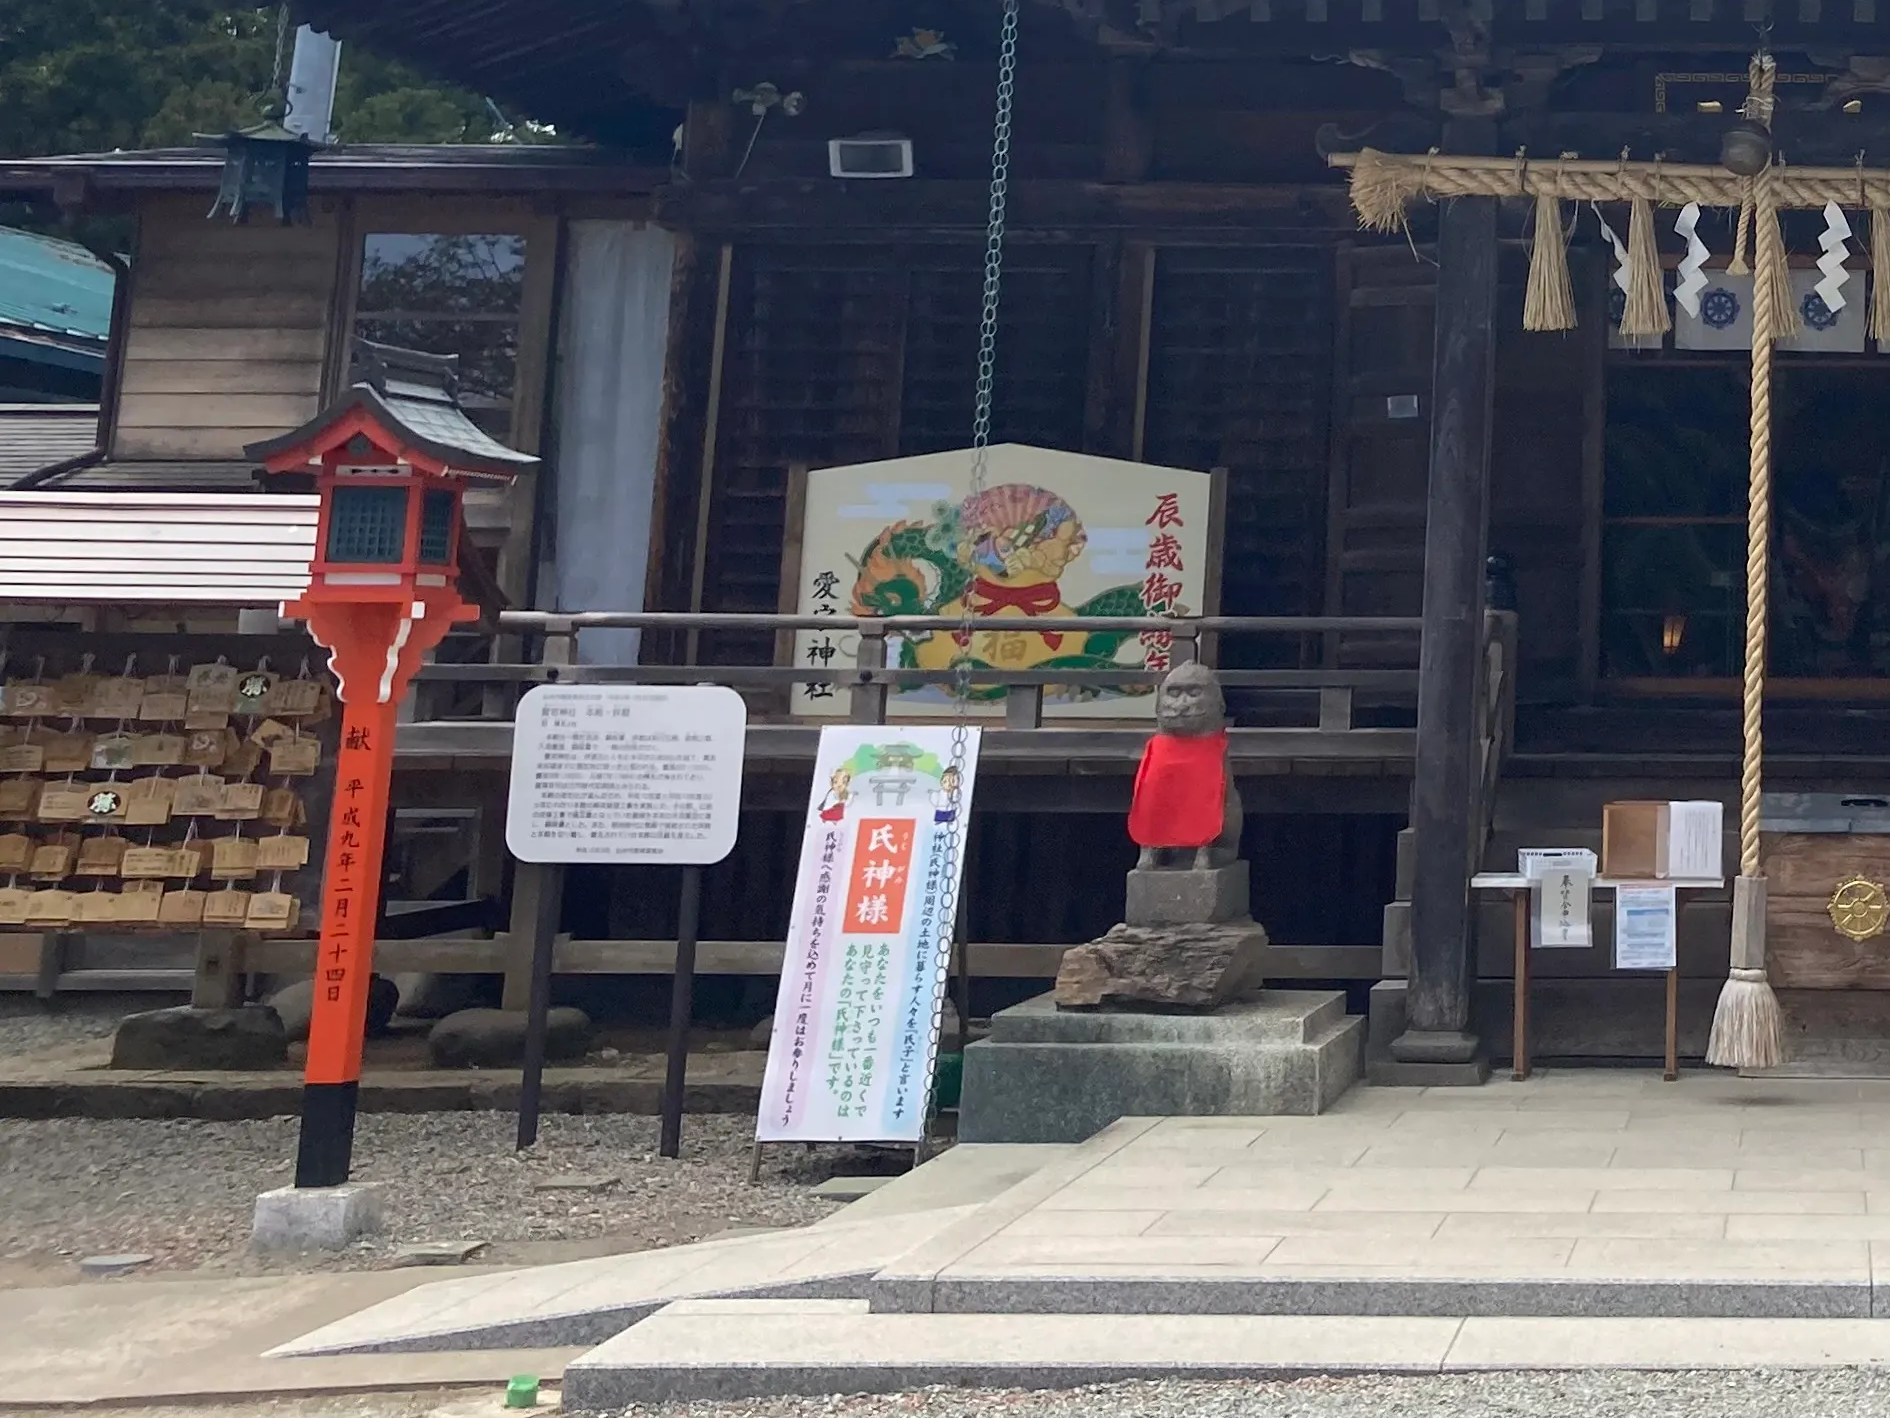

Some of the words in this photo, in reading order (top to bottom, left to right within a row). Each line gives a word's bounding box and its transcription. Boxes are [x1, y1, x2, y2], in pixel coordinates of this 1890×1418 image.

[346, 725, 371, 751] 献
[326, 778, 364, 1002] 平成九年二月二十四日
[855, 823, 898, 925] 氏神様
[837, 944, 874, 1118] 見守って下さっているのは
[855, 943, 890, 1118] あなたをいつも一番近くで
